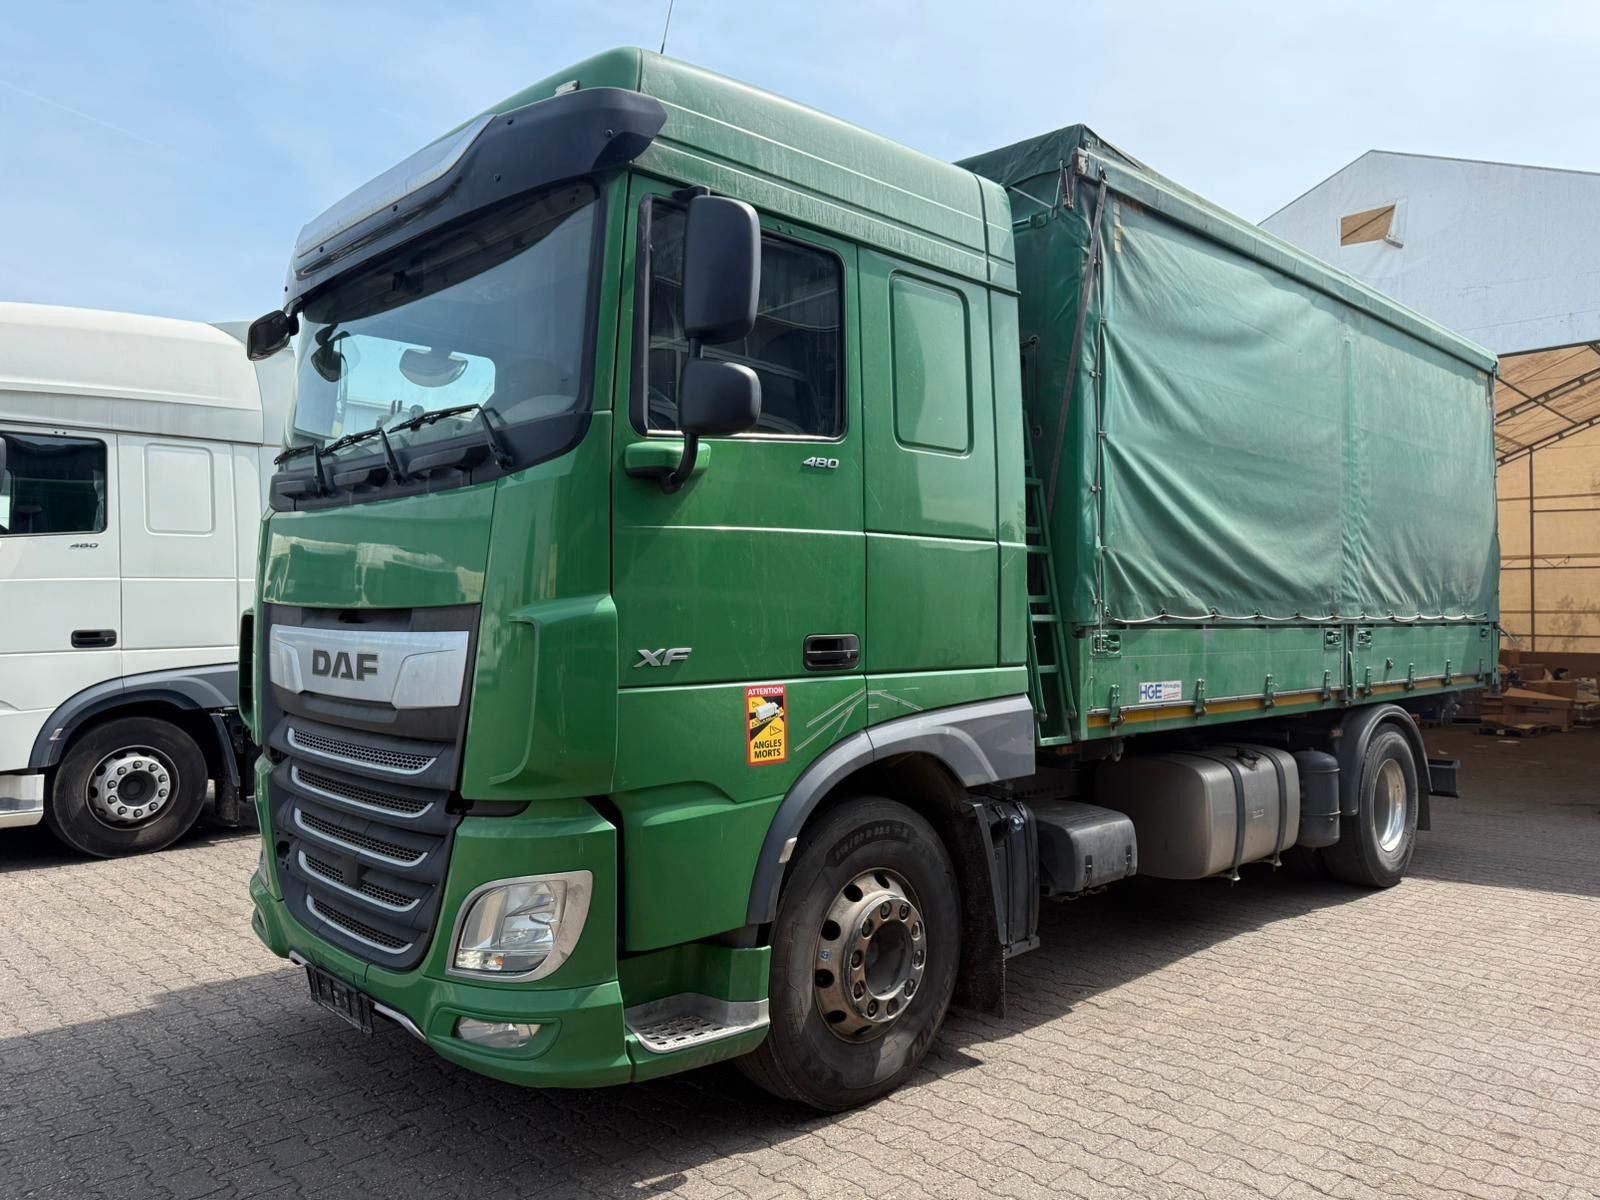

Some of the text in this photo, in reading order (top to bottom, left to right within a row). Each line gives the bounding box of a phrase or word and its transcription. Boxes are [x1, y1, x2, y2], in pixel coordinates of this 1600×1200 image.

[803, 456, 840, 469] 480
[633, 647, 693, 668] XF
[311, 649, 379, 681] DAF
[747, 687, 784, 696] ATTENTION
[1139, 683, 1162, 701] HGE
[753, 739, 782, 750] ANGLES
[754, 747, 781, 759] MORTS
